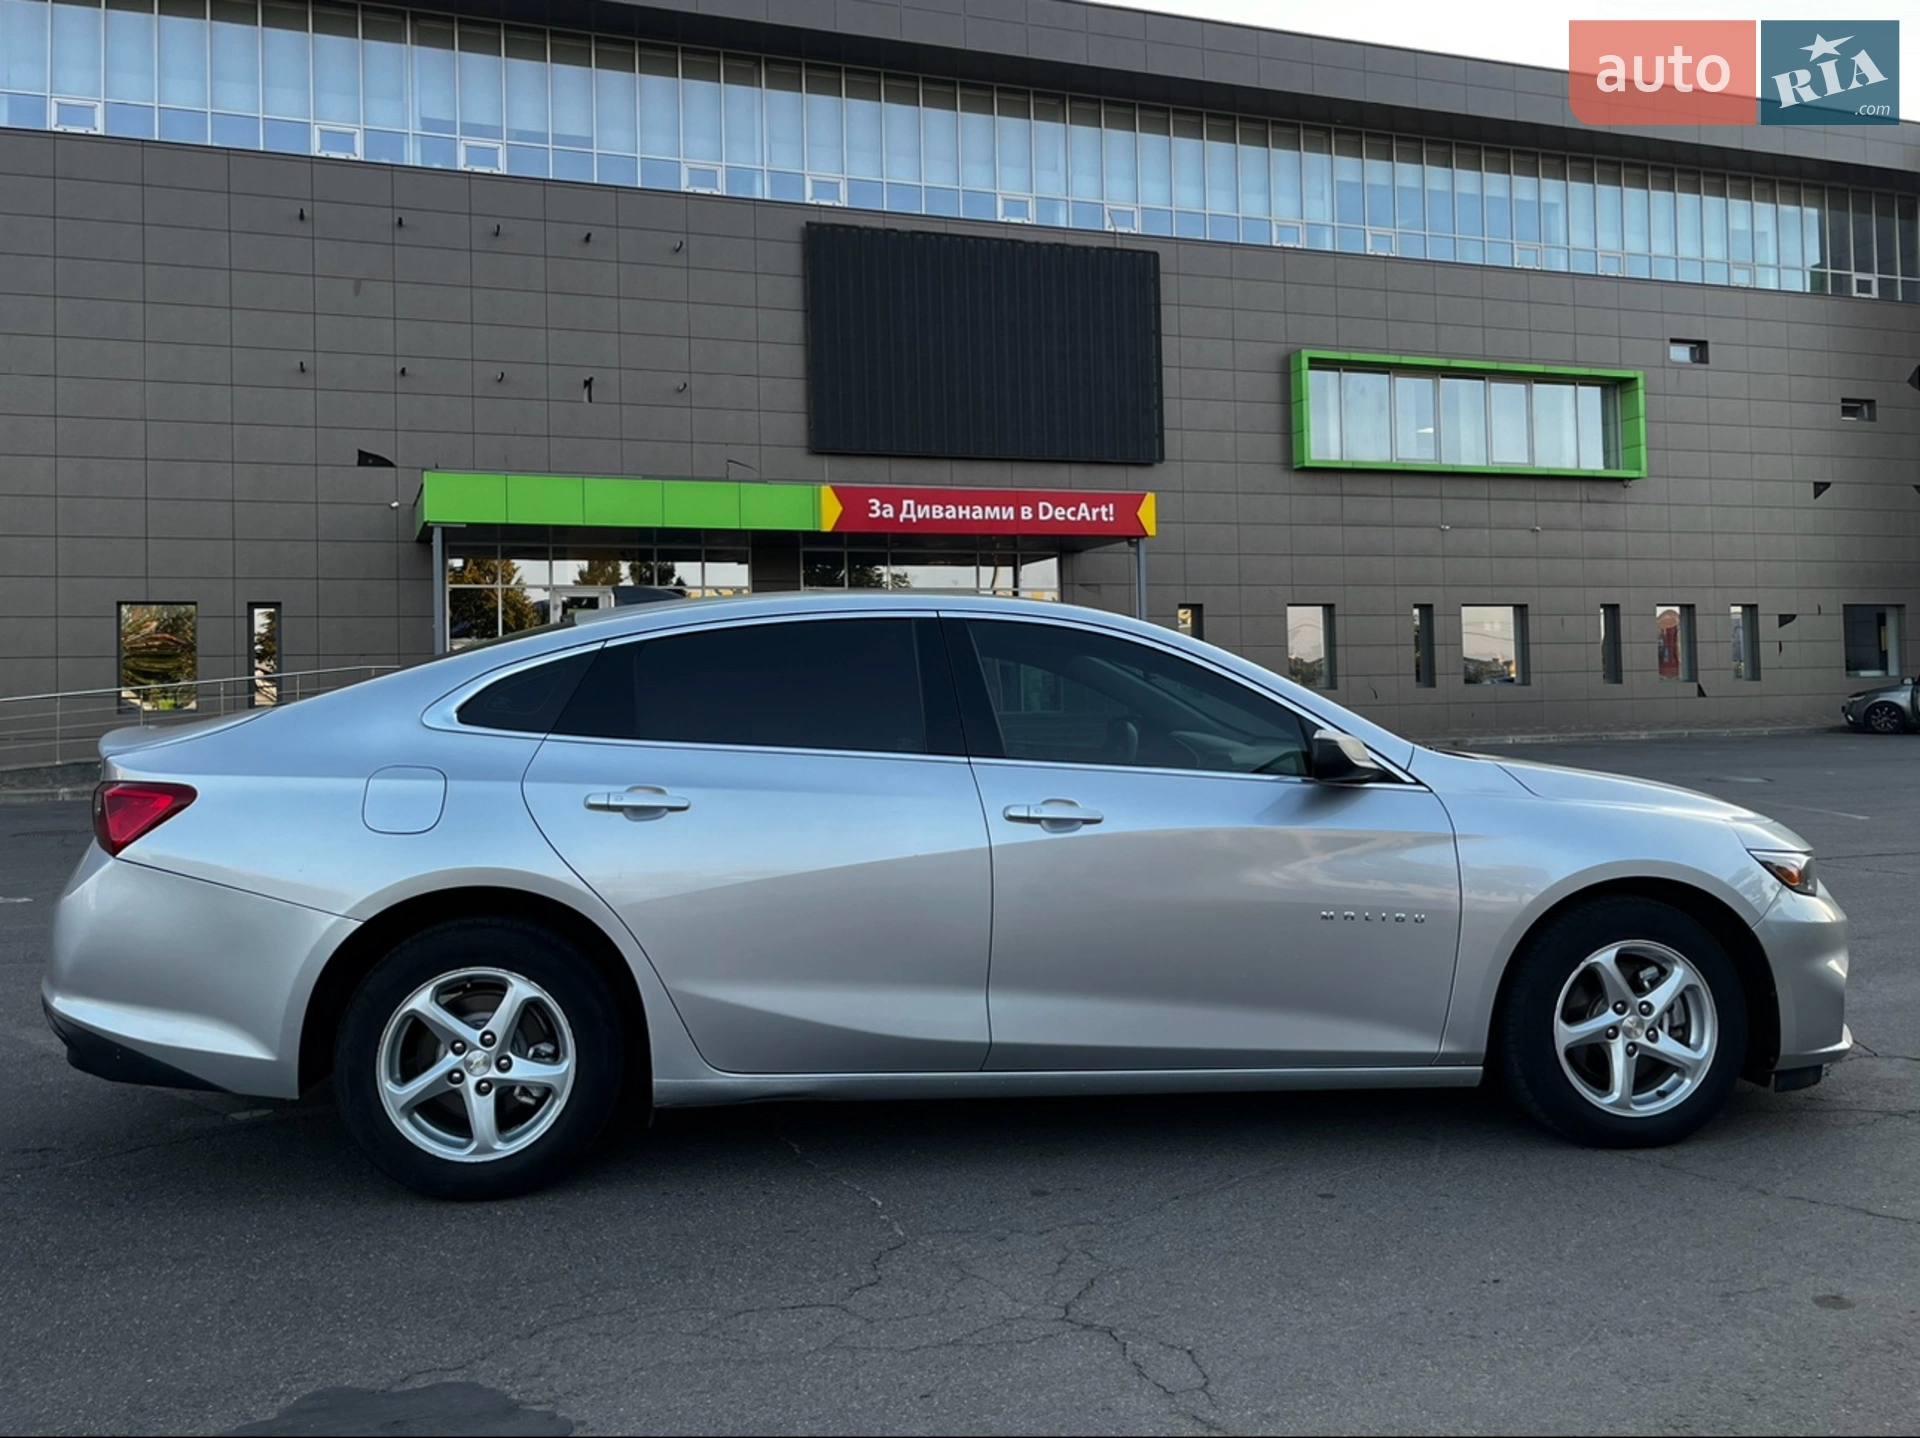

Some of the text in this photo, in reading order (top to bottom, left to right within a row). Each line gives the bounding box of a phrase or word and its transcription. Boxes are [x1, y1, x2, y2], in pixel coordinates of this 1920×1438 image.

[868, 498, 1114, 523] За Диванами в DecArt!
[1320, 911, 1425, 923] MALIBU
